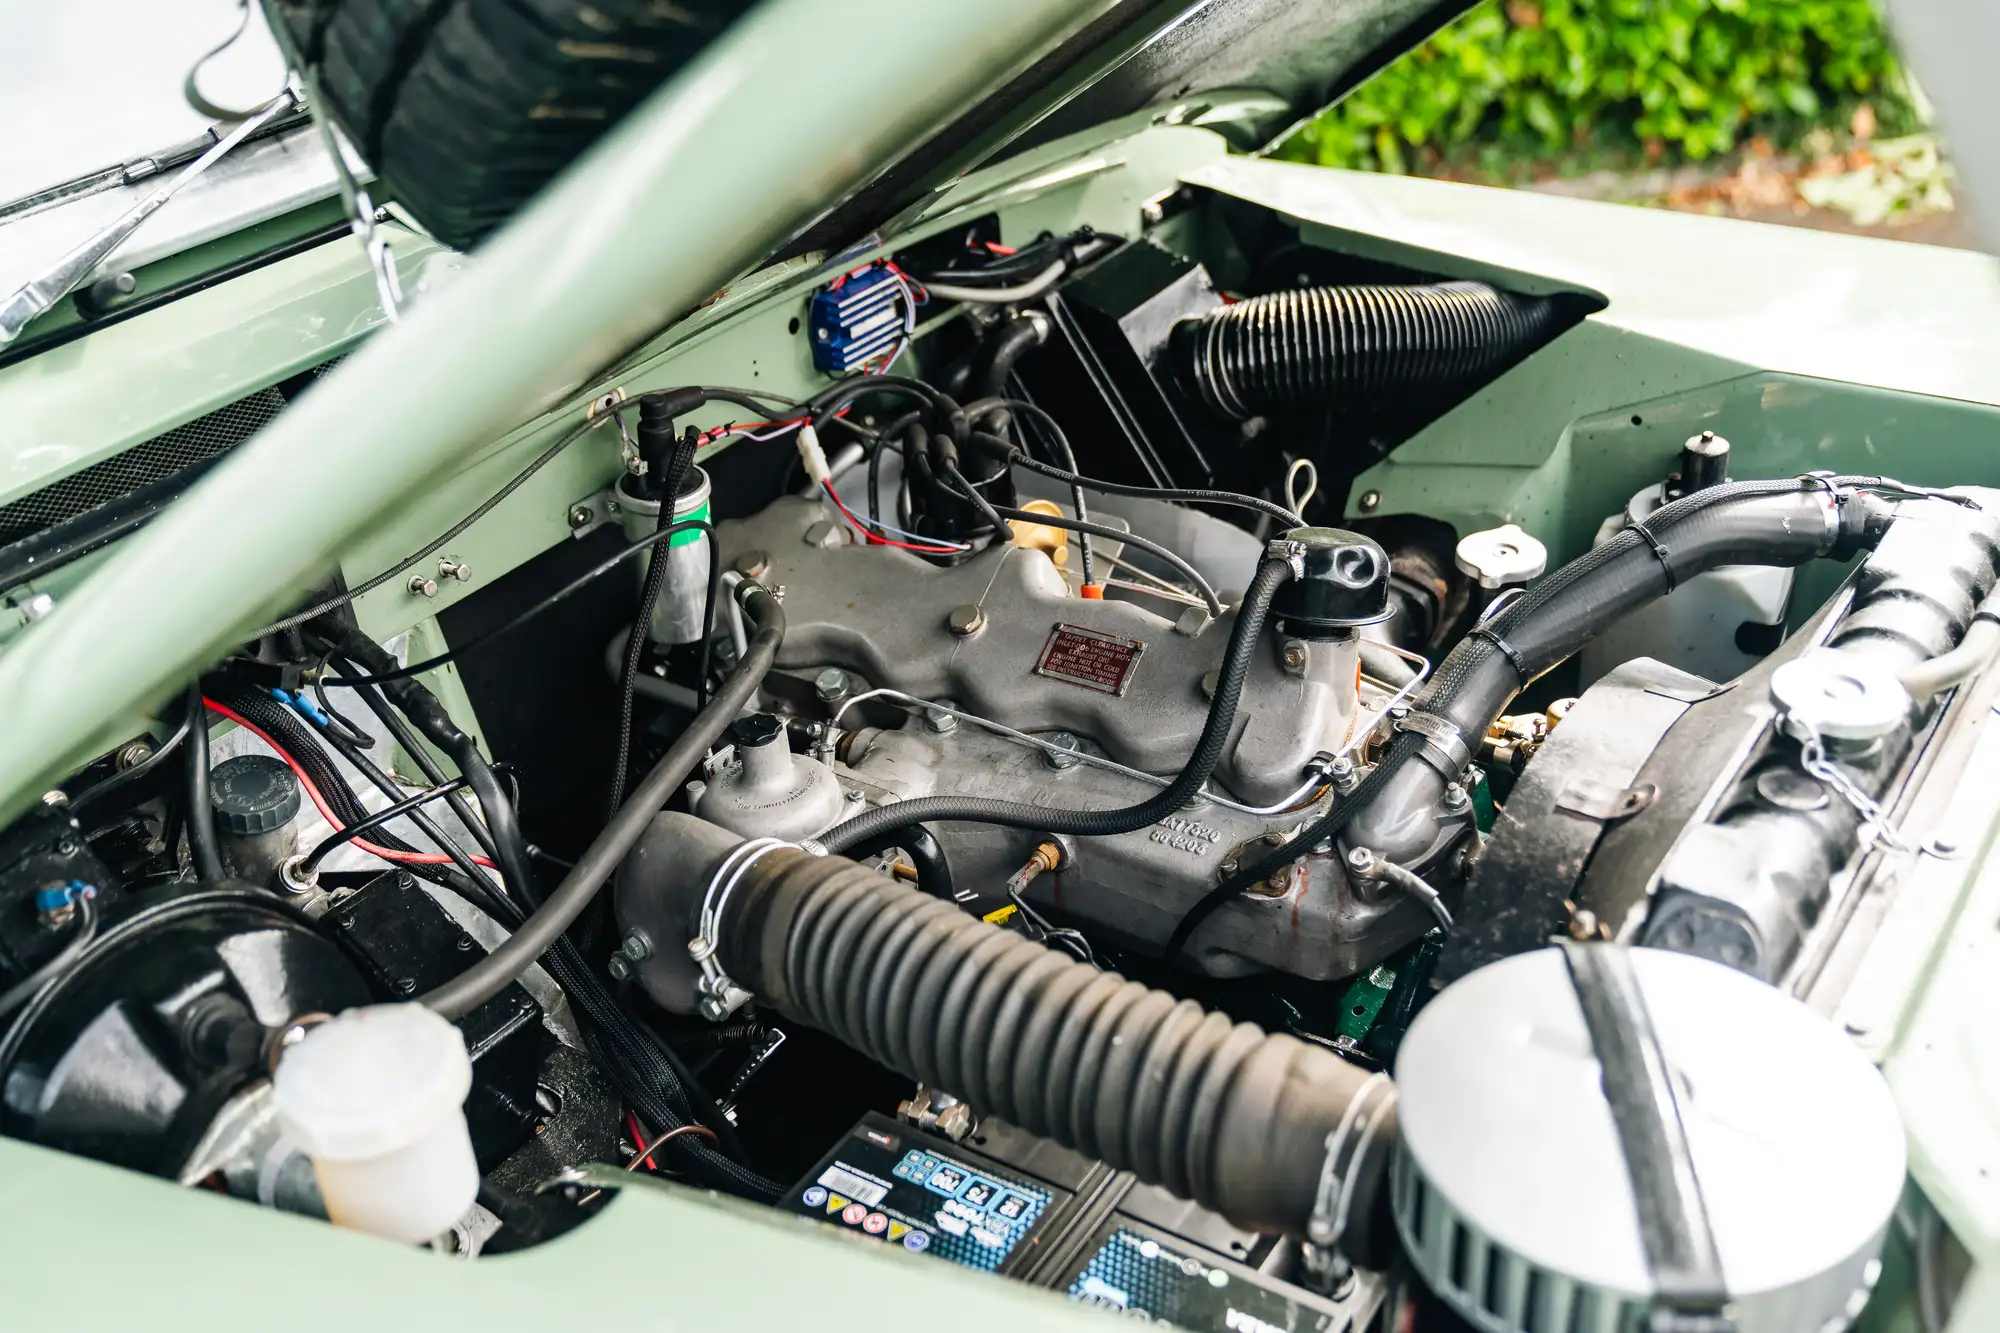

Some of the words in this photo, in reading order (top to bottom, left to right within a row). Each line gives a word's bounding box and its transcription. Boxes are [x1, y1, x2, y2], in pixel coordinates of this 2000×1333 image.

[1056, 639, 1076, 649] INLET
[1090, 647, 1116, 658] ENGINE
[1064, 633, 1087, 644] TAPPET
[1090, 640, 1128, 654] CLEARANCE
[1052, 652, 1078, 663] ENGINE
[1079, 658, 1092, 666] HOT
[1092, 661, 1103, 669] OR
[1103, 664, 1120, 673] COLD
[1068, 649, 1098, 660] EXHAUST
[1050, 658, 1062, 666] FOR
[1063, 661, 1094, 673] IGNITION
[1094, 669, 1117, 679] TIMING
[931, 1172, 960, 1193] 700
[965, 1187, 988, 1205] 75
[999, 1201, 1021, 1218] 12
